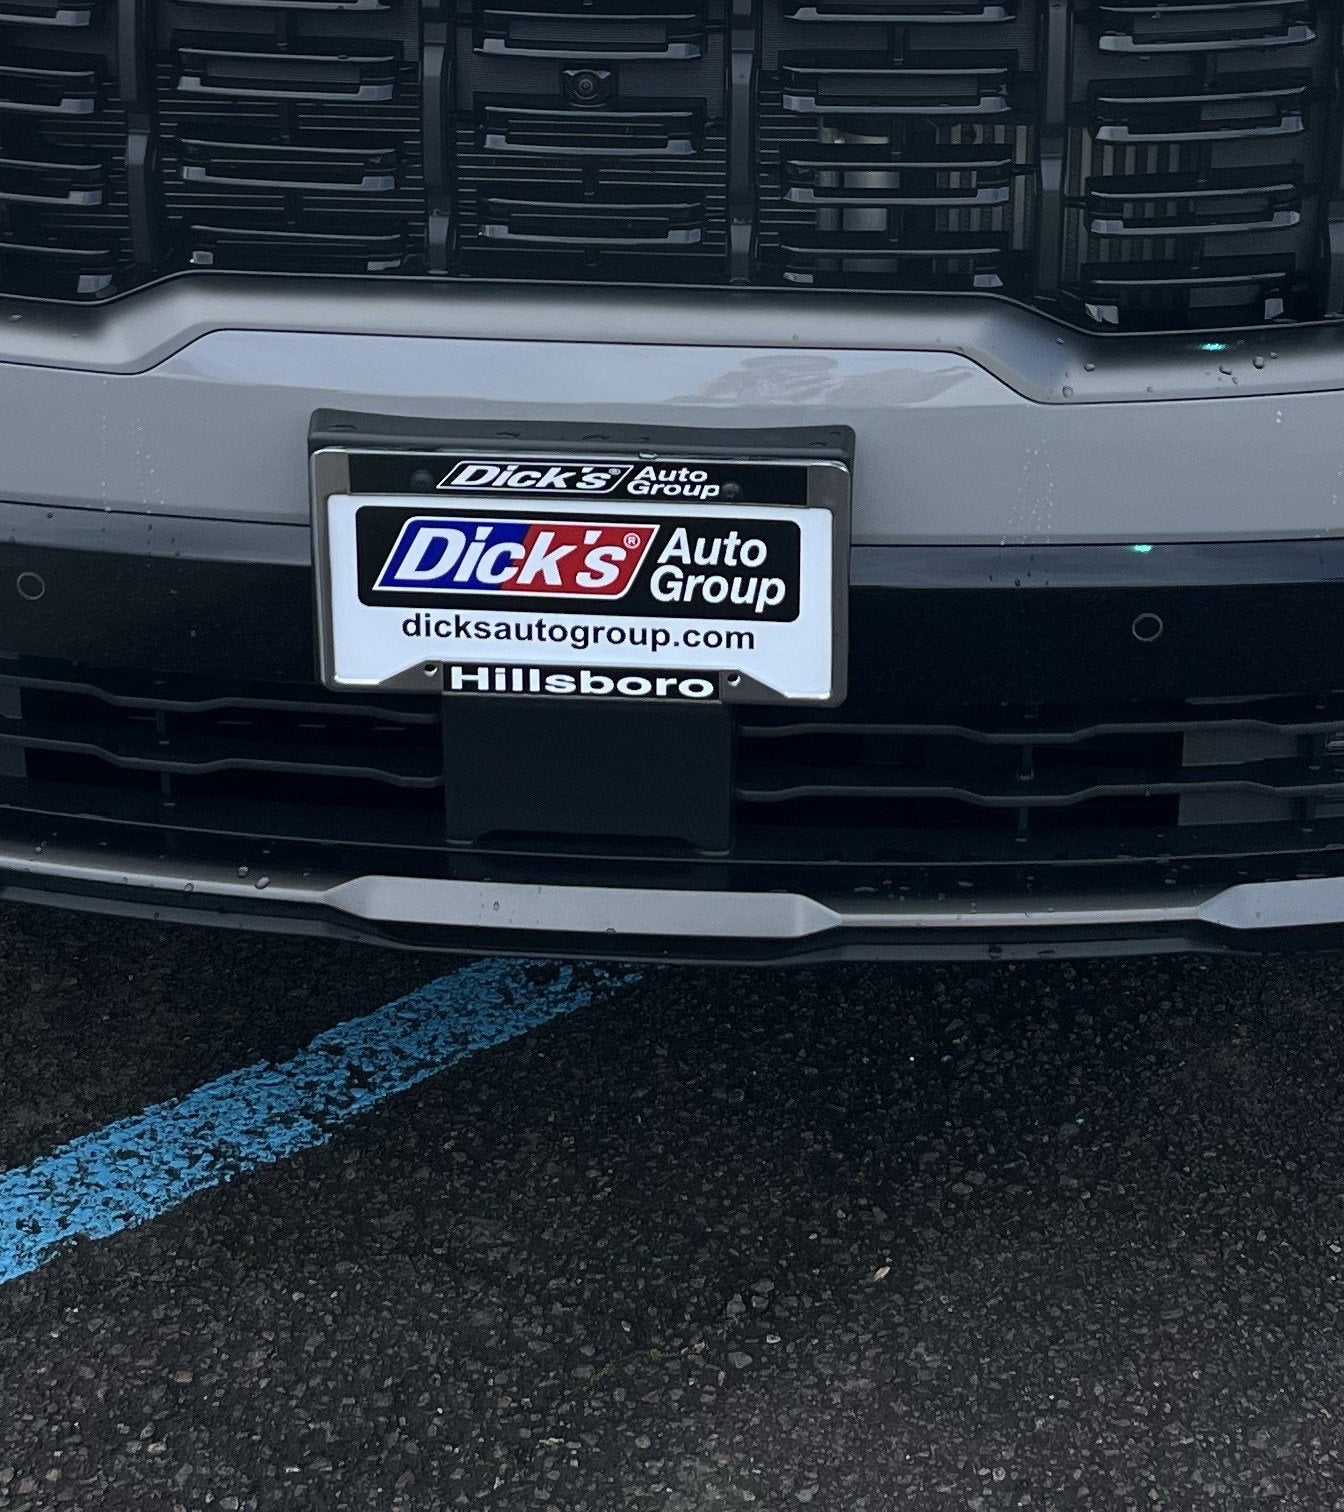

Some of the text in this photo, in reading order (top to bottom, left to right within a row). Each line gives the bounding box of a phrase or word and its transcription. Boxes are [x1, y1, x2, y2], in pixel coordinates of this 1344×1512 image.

[627, 480, 720, 500] Group
[634, 466, 708, 483] Auto
[658, 527, 767, 568] Auto
[650, 565, 786, 613] Group
[402, 613, 755, 652] dicksautogroup.com
[451, 665, 714, 698] Hillsboro
